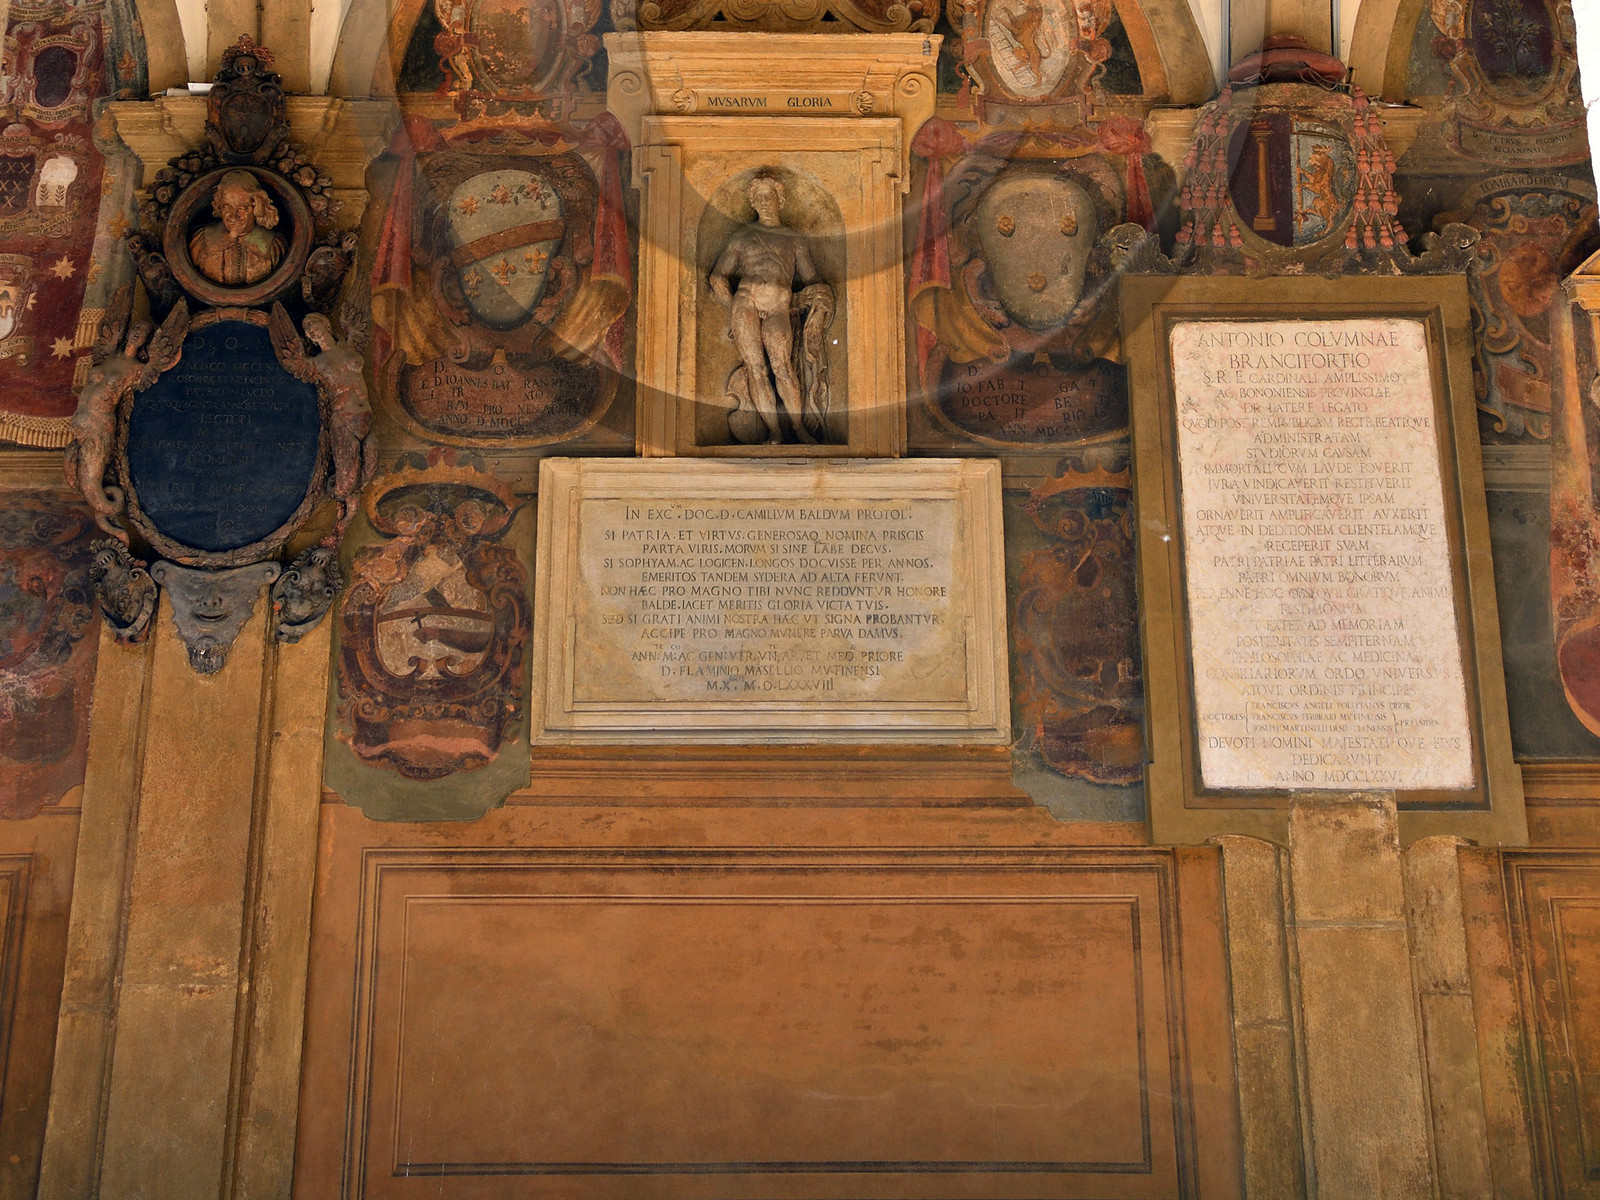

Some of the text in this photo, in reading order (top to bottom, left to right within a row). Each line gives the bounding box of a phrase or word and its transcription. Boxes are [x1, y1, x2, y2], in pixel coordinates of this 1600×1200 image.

[707, 97, 833, 107] MVSARVM GLORIA
[1198, 332, 1399, 347] ANTONIO COLVMNAE
[1230, 352, 1370, 369] BRANCIFORTIO
[1248, 372, 1401, 384] CARDINALI AMPLISSIMO
[1240, 388, 1316, 398] BONONIENSIS
[1321, 388, 1391, 398] PROVINCIAE
[1322, 402, 1368, 413] LEGATO
[1253, 432, 1361, 444] ADMINISTRATAM
[1246, 447, 1371, 458] STVDIORVM CAVSAM
[1277, 463, 1307, 474] CVM
[1314, 463, 1353, 474] LAVDE
[1360, 463, 1412, 474] FOVERIT
[1232, 492, 1395, 508] VNIVERSITATEMQVE IPSAM
[625, 505, 850, 520] IN CAMILLVM BALDVM
[1196, 509, 1430, 520] ORNAVERIT AMPLIFICAVERIT AVXERIT
[604, 530, 615, 541] SI
[678, 530, 694, 541] ET
[825, 530, 877, 541] NOMINA
[882, 530, 924, 541] PRISCIS
[1196, 523, 1437, 541] ATQVE IN DEDITIONEM CLIENTELAMQVE
[642, 544, 684, 554] PARTA
[724, 544, 767, 554] MORVM
[783, 544, 807, 554] SINE
[814, 544, 844, 554] LABE
[1266, 540, 1369, 551] RECEPERIT SVAM
[603, 558, 614, 568] SI
[680, 558, 694, 568] AC
[750, 558, 795, 568] LONGOS
[800, 558, 857, 568] DOCVISSE
[862, 558, 882, 568] PER
[1310, 556, 1343, 567] PATRI
[1348, 556, 1422, 567] LITTERARVM
[641, 572, 697, 582] EMERITOS
[701, 572, 748, 582] TANDEM
[753, 572, 797, 582] SYDERA
[800, 572, 817, 582] AD
[820, 572, 850, 582] ALTA
[1279, 571, 1332, 583] OMNIVM
[601, 586, 947, 597] NON PRO MAGNO TIBI NVNC REDDVNTVR HONORE
[682, 600, 714, 610] IACET
[718, 600, 763, 610] MERITIS
[767, 600, 813, 610] GLORIA
[817, 600, 853, 610] VICTA
[602, 614, 624, 625] SED
[627, 614, 637, 625] SI
[642, 614, 681, 625] GRATI
[685, 614, 720, 625] ANIMI
[724, 614, 768, 625] NOSTRA
[803, 614, 820, 625] VT
[824, 614, 861, 625] SIGNA
[1307, 619, 1404, 630] AD MEMORIAM
[641, 628, 685, 638] ACCIPE
[693, 628, 718, 638] PRO
[724, 628, 767, 638] MAGNO
[770, 628, 816, 638] MVNERE
[820, 628, 852, 638] PARVA
[1324, 635, 1415, 647] SEMPITERNAM
[806, 651, 820, 661] ET
[860, 651, 903, 661] PRIORE
[1324, 668, 1365, 679] ORDO
[1208, 737, 1255, 749] DEVOTI
[1275, 770, 1315, 782] ANNO
